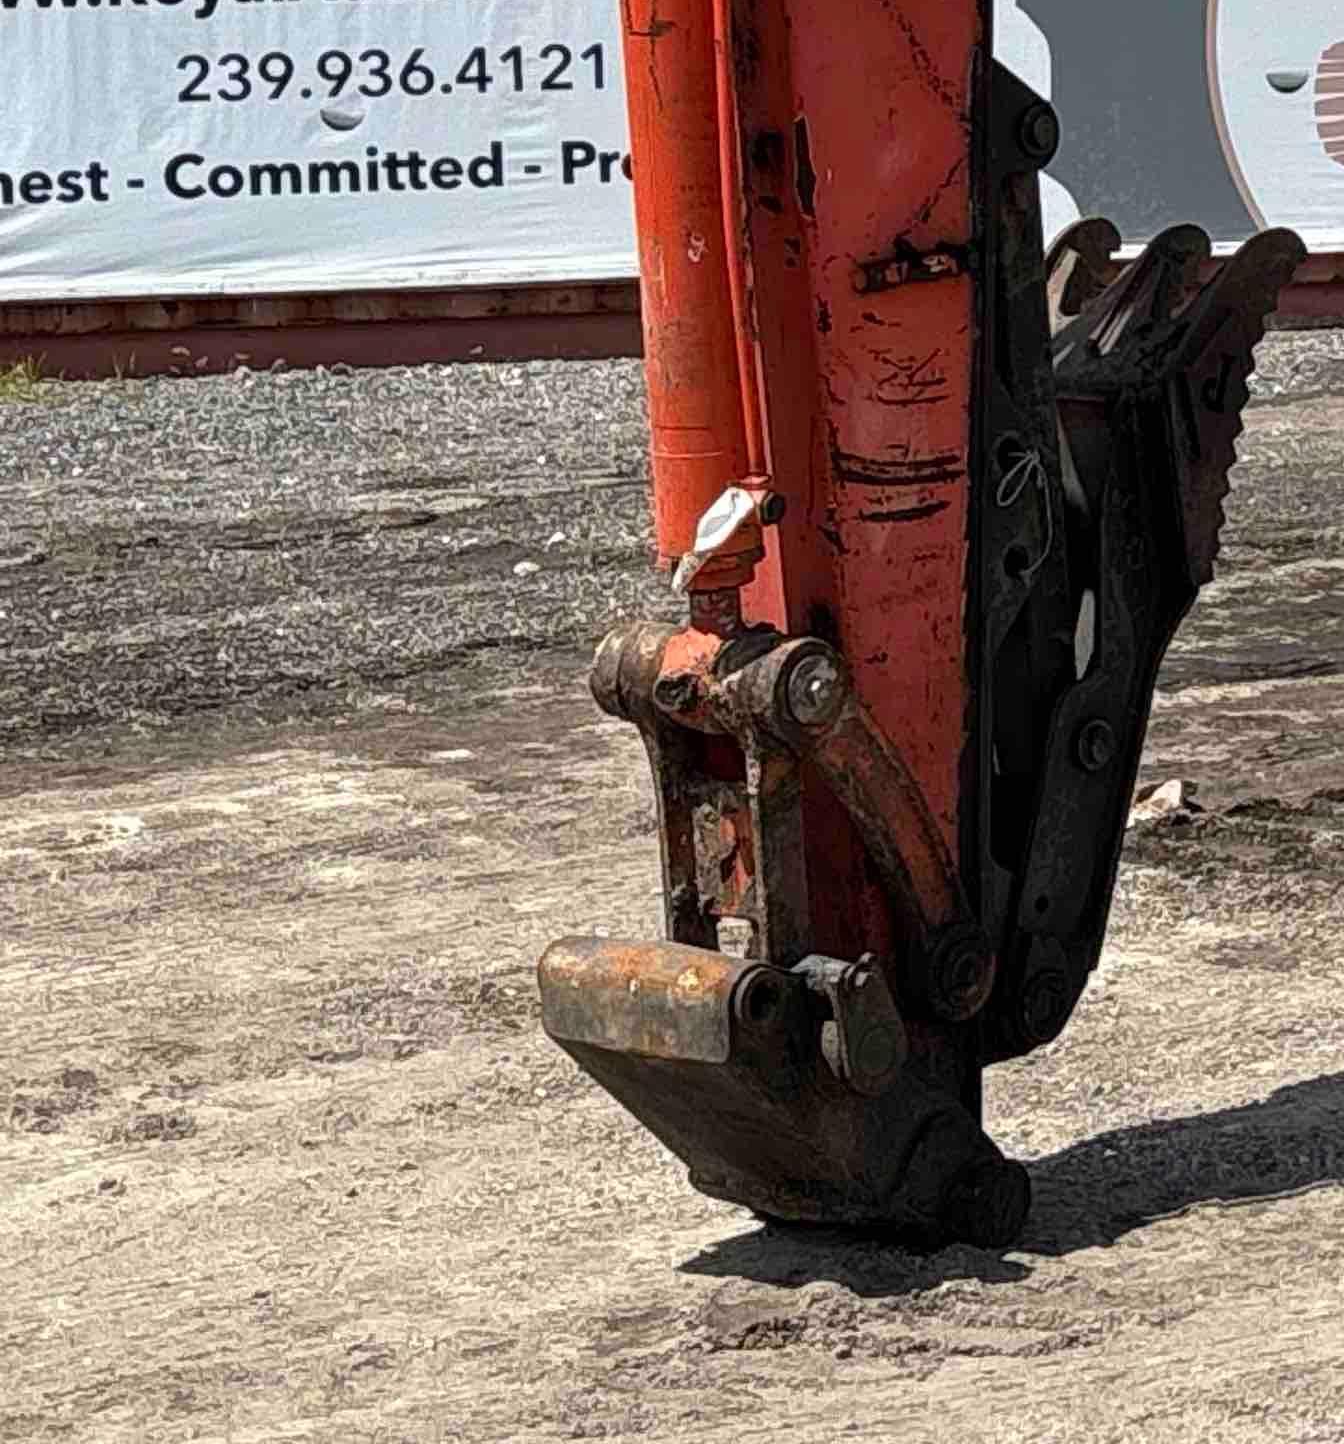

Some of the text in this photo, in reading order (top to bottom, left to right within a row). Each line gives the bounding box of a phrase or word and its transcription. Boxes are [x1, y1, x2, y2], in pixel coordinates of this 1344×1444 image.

[176, 42, 604, 103] 239.936.4121
[164, 141, 504, 199] Committed
[561, 140, 632, 185] Pr
